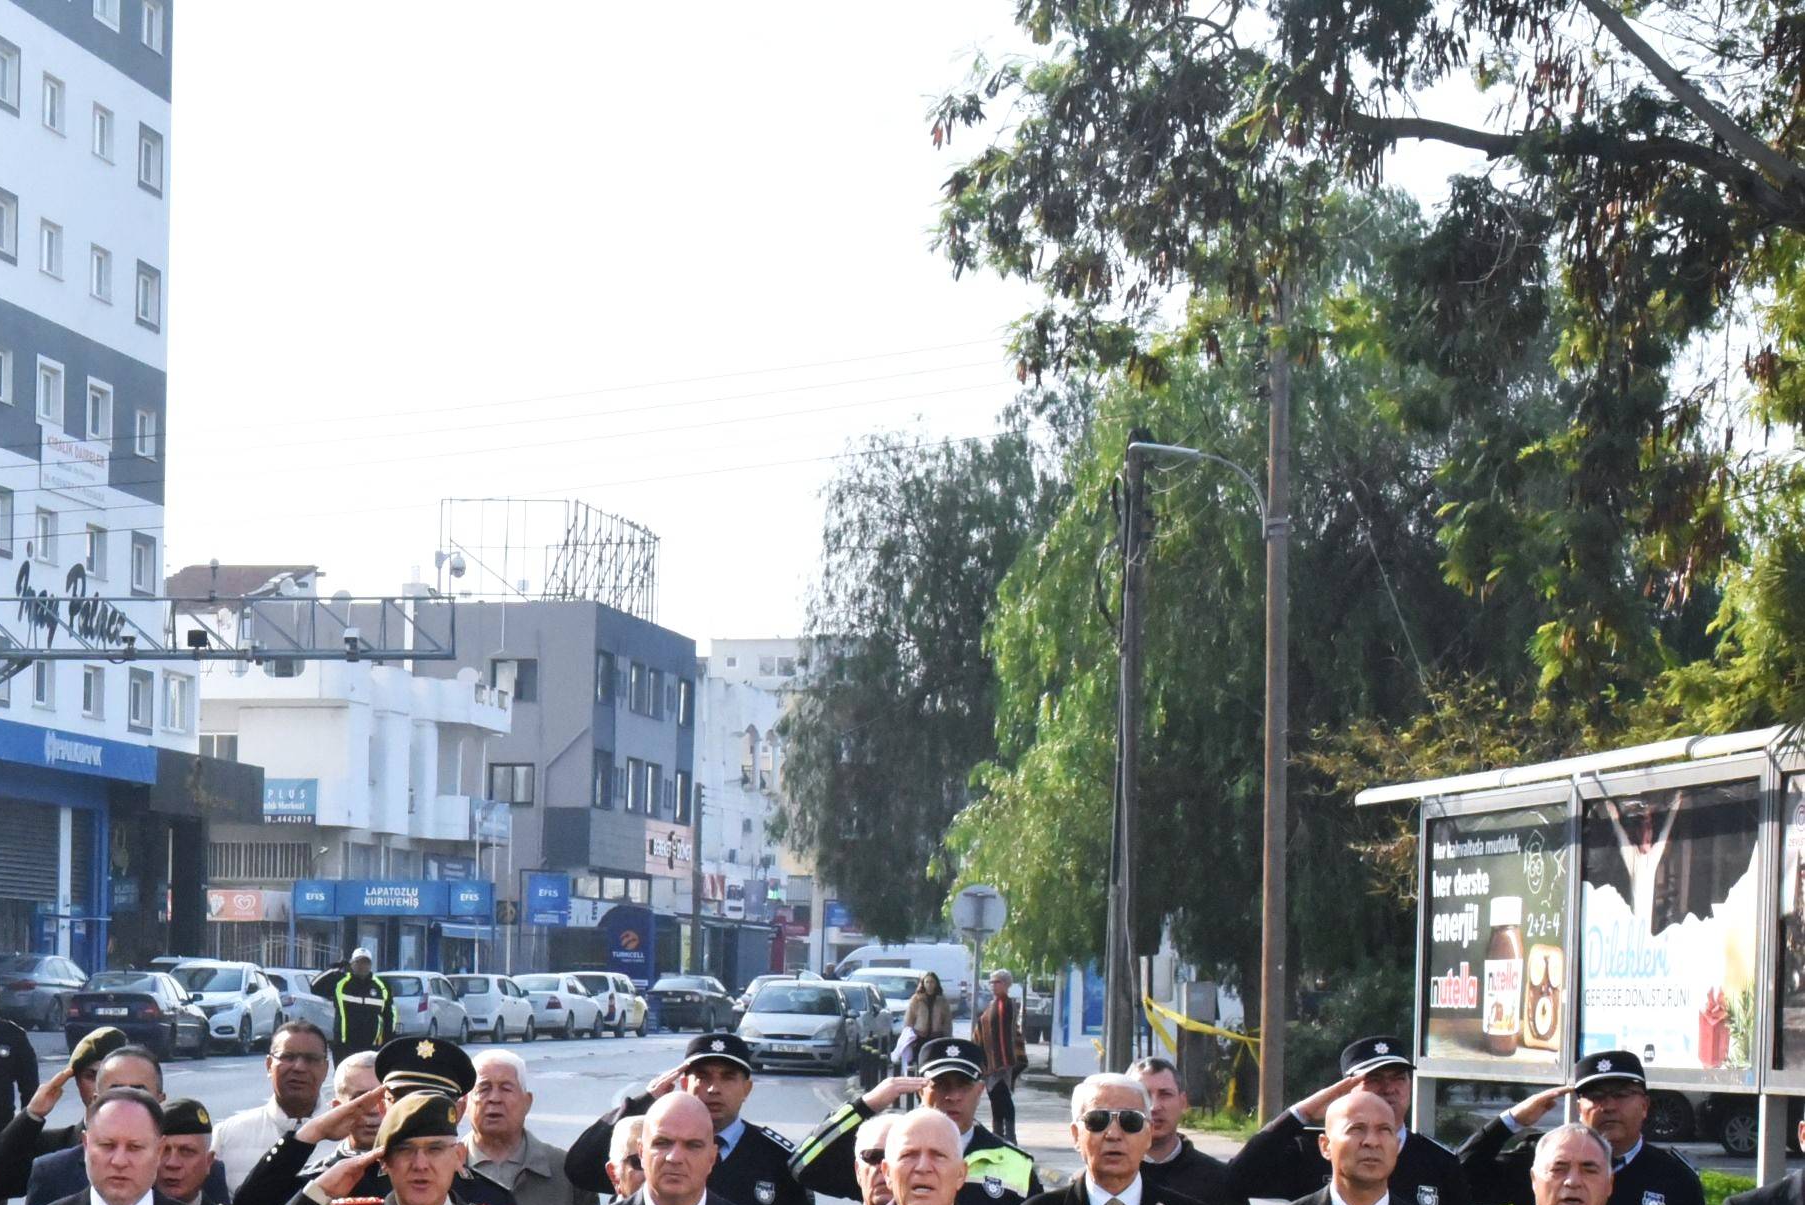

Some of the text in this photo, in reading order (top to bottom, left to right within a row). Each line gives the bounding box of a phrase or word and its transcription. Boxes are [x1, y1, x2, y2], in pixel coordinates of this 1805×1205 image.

[365, 886, 419, 896] LAPATOZLU
[1432, 867, 1490, 898] her derste
[364, 896, 419, 909] KURUYEMİŞ
[1432, 903, 1479, 948] enerji!
[612, 950, 646, 959] TURKCELL
[1430, 961, 1478, 1009] nutella
